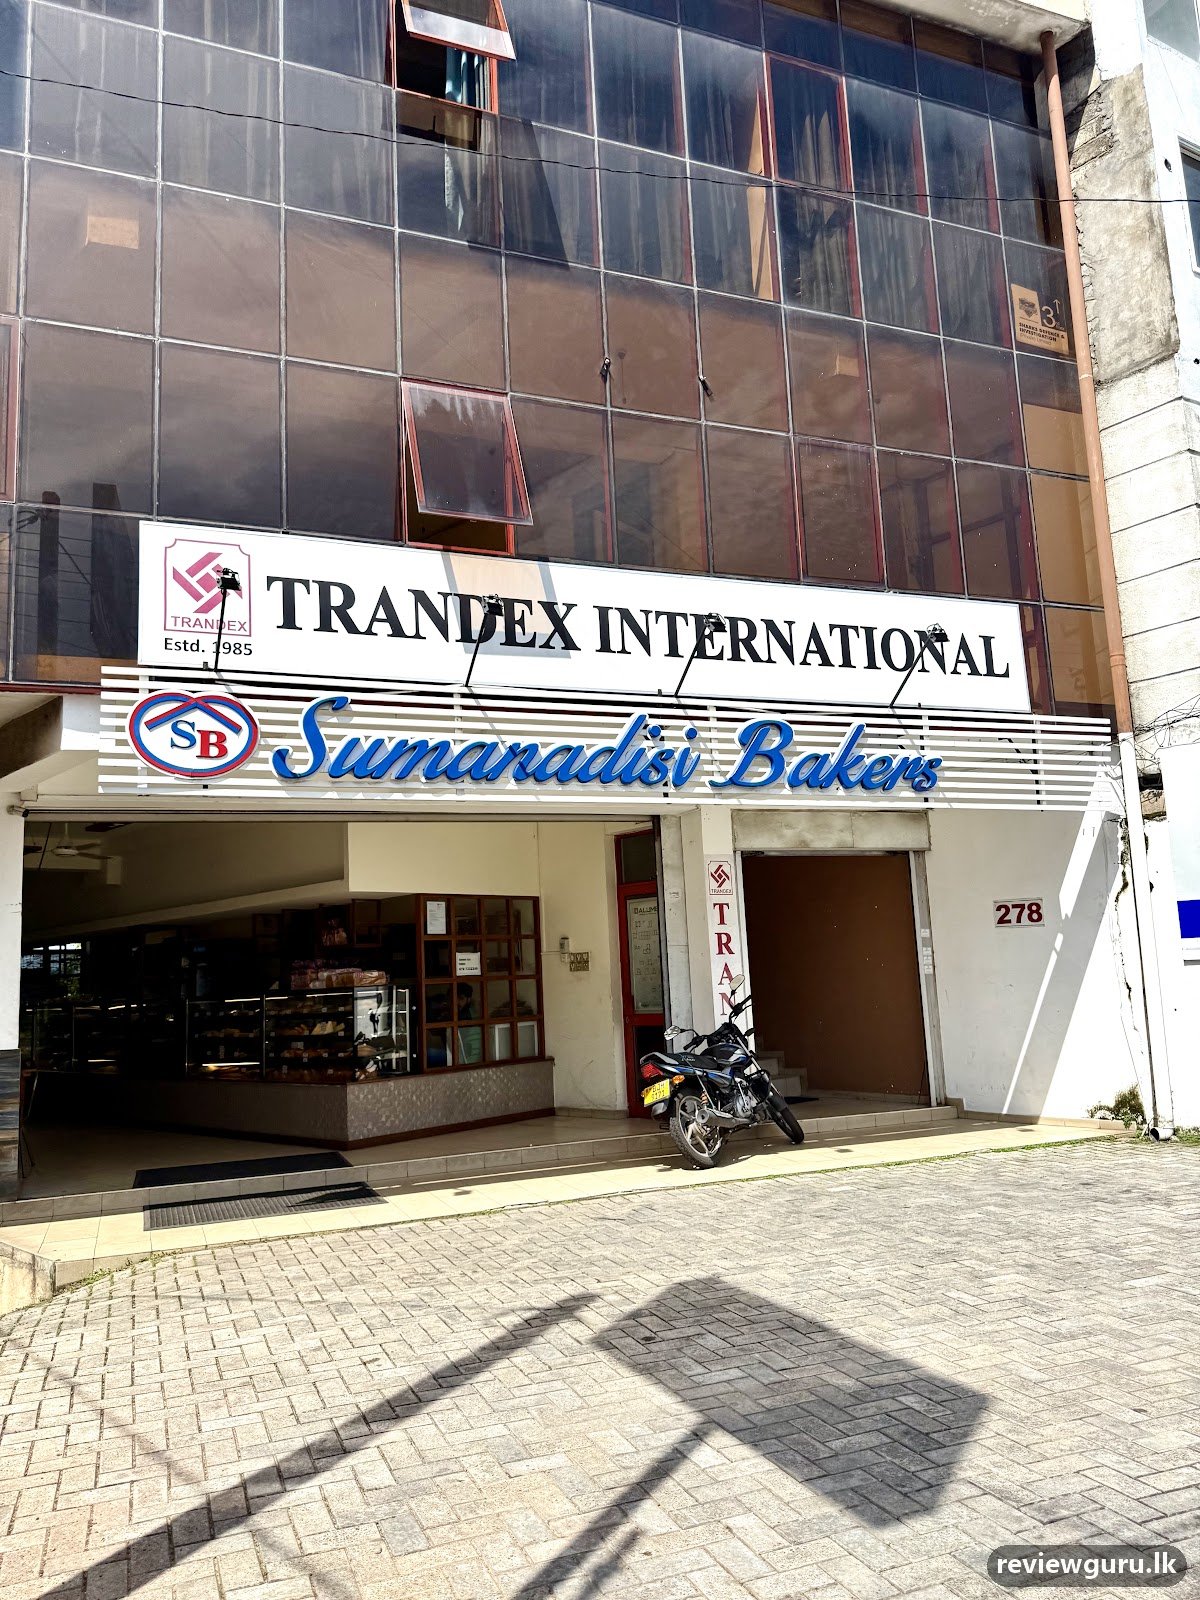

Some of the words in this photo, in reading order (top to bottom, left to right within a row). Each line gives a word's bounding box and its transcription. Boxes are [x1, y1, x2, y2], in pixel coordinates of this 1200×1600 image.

[1019, 328, 1057, 342] INVESTIGATION
[171, 615, 247, 632] TRANDEX
[266, 575, 581, 651] TRANDEX
[593, 604, 1010, 679] INTERNATIONAL
[164, 637, 206, 653] Estd.
[212, 640, 253, 656] 1985
[272, 695, 701, 789] Sumanadisi
[708, 717, 943, 792] Bakers
[995, 902, 1043, 925] 278
